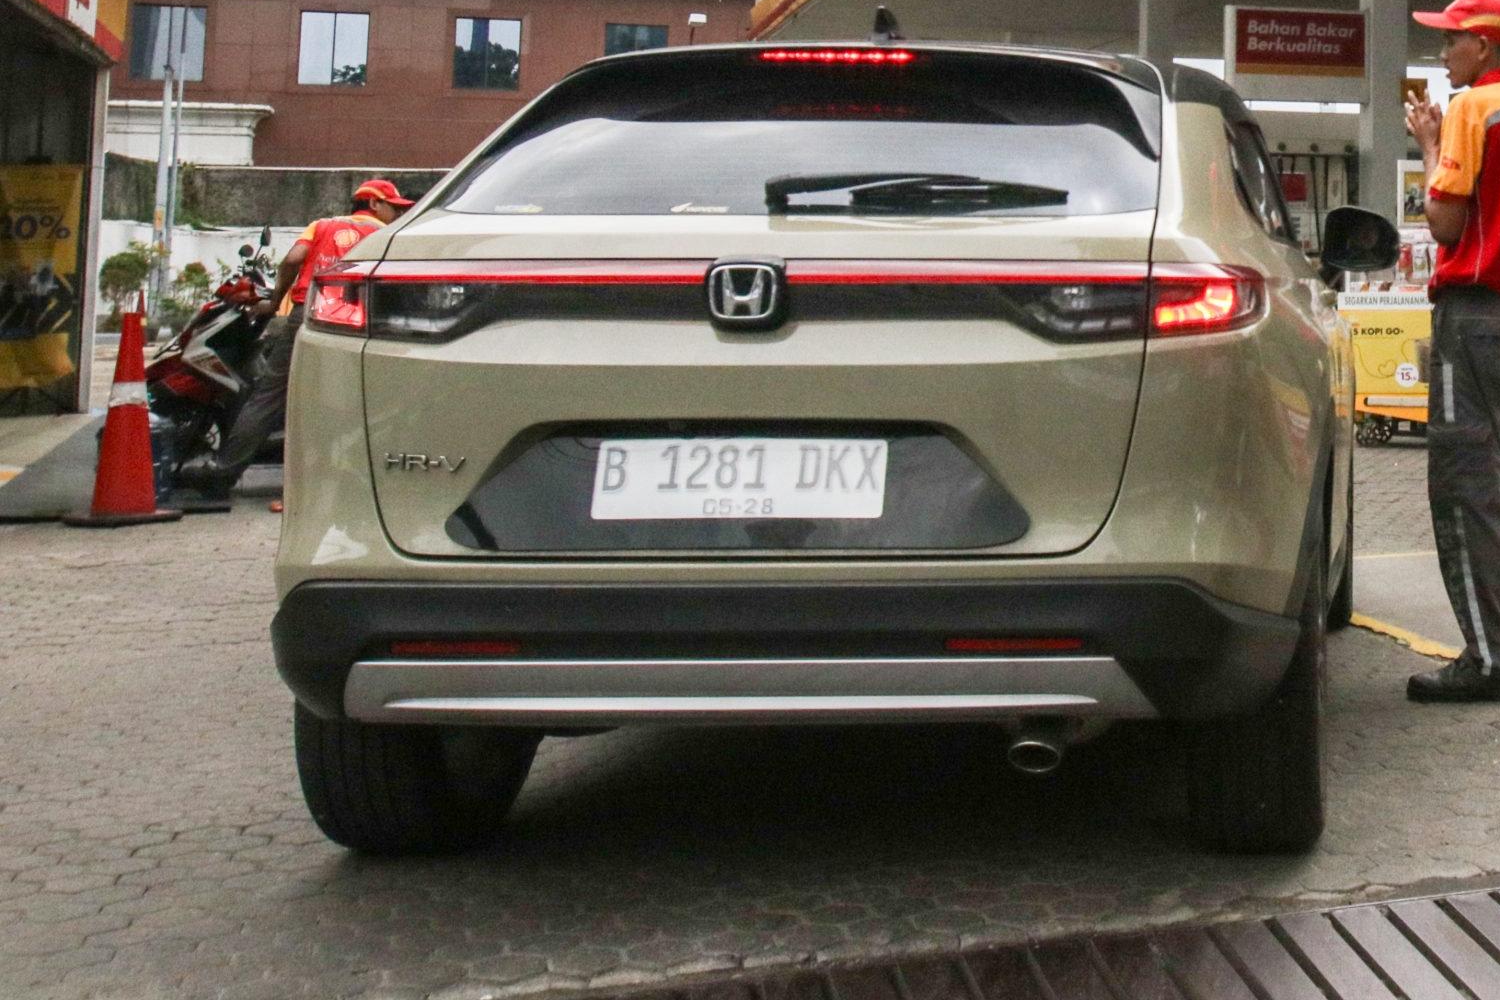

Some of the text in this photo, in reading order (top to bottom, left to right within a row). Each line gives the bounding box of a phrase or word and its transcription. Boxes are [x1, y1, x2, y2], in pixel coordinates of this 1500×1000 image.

[1247, 20, 1357, 38] Bahan Bakar
[1247, 37, 1341, 55] Berkualitas
[1344, 296, 1378, 306] SEGARKAN
[1361, 327, 1383, 336] KOPI
[384, 453, 466, 474] HR-V
[602, 445, 883, 492] B 1281 DKX
